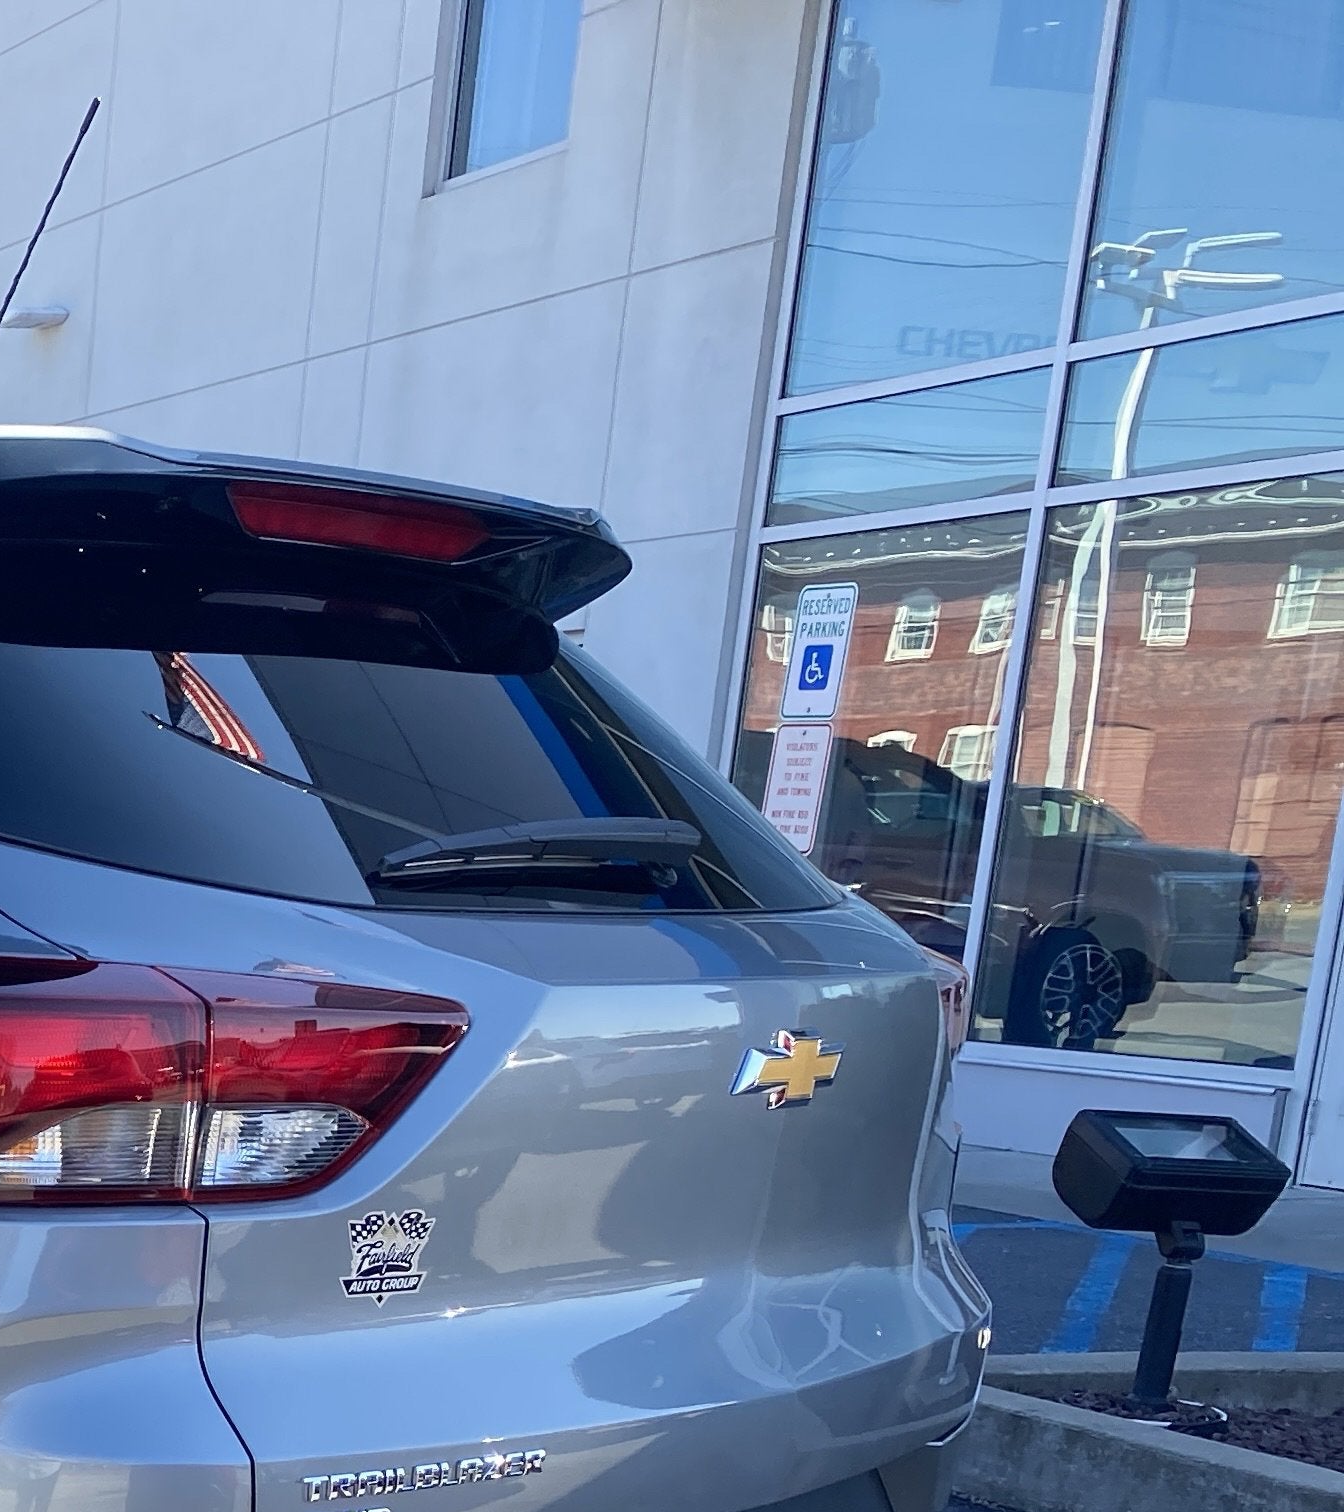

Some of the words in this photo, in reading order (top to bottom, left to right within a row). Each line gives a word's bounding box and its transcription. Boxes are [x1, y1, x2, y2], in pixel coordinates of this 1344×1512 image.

[898, 325, 1059, 359] CHEVR
[802, 598, 851, 616] RESERVED
[799, 621, 845, 639] PARKING
[348, 1280, 380, 1293] AUTO
[381, 1277, 419, 1291] GROUP
[302, 1449, 547, 1502] TRAILBLAZER
